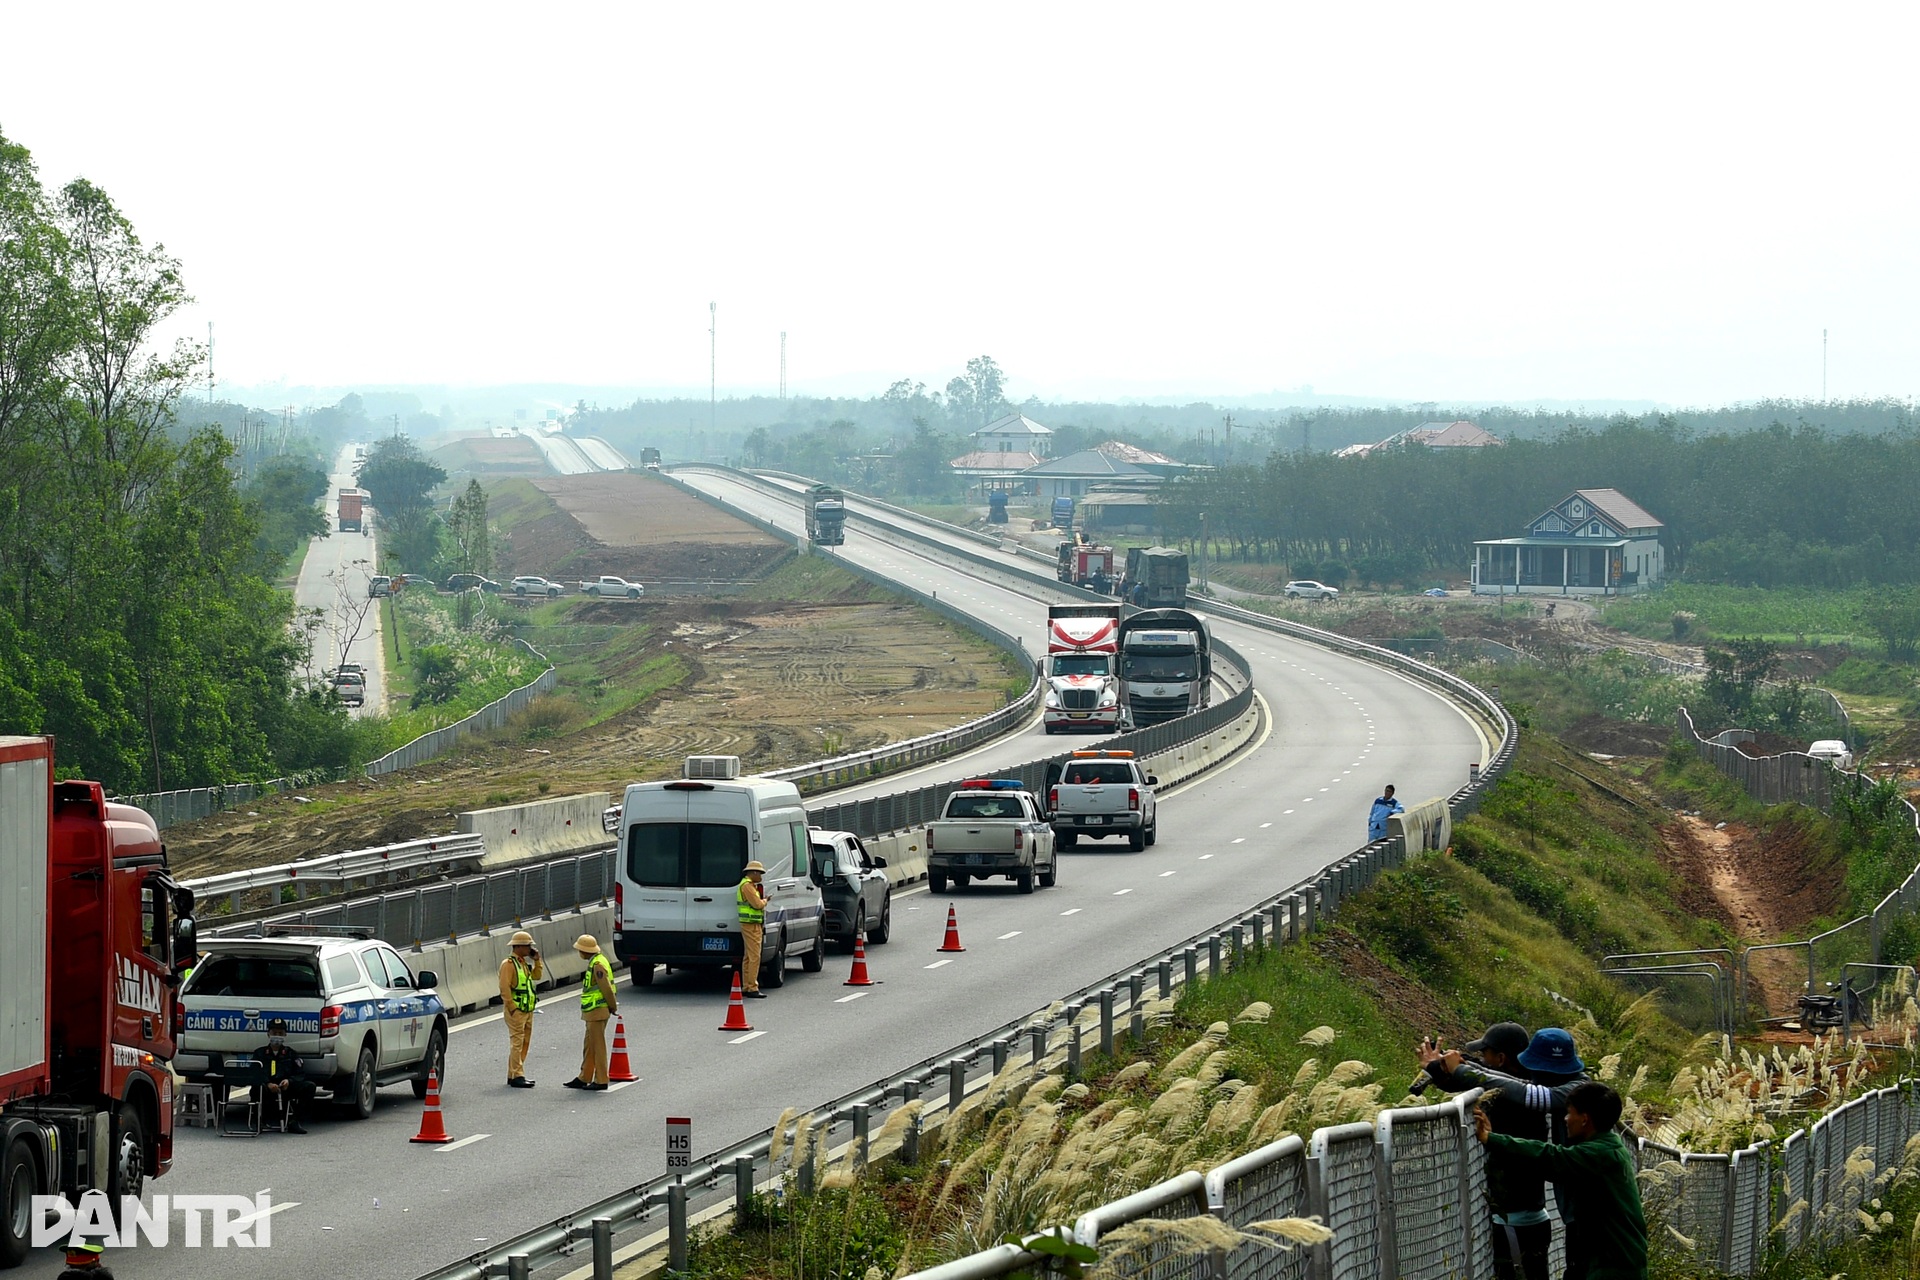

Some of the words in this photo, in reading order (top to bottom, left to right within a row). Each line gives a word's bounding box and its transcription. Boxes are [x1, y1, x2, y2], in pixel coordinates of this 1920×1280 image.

[186, 1012, 215, 1030] CẢNH
[219, 1015, 241, 1030] SÁT
[286, 1015, 319, 1032] THÔNG
[669, 1135, 688, 1149] H5
[668, 1156, 688, 1167] 635
